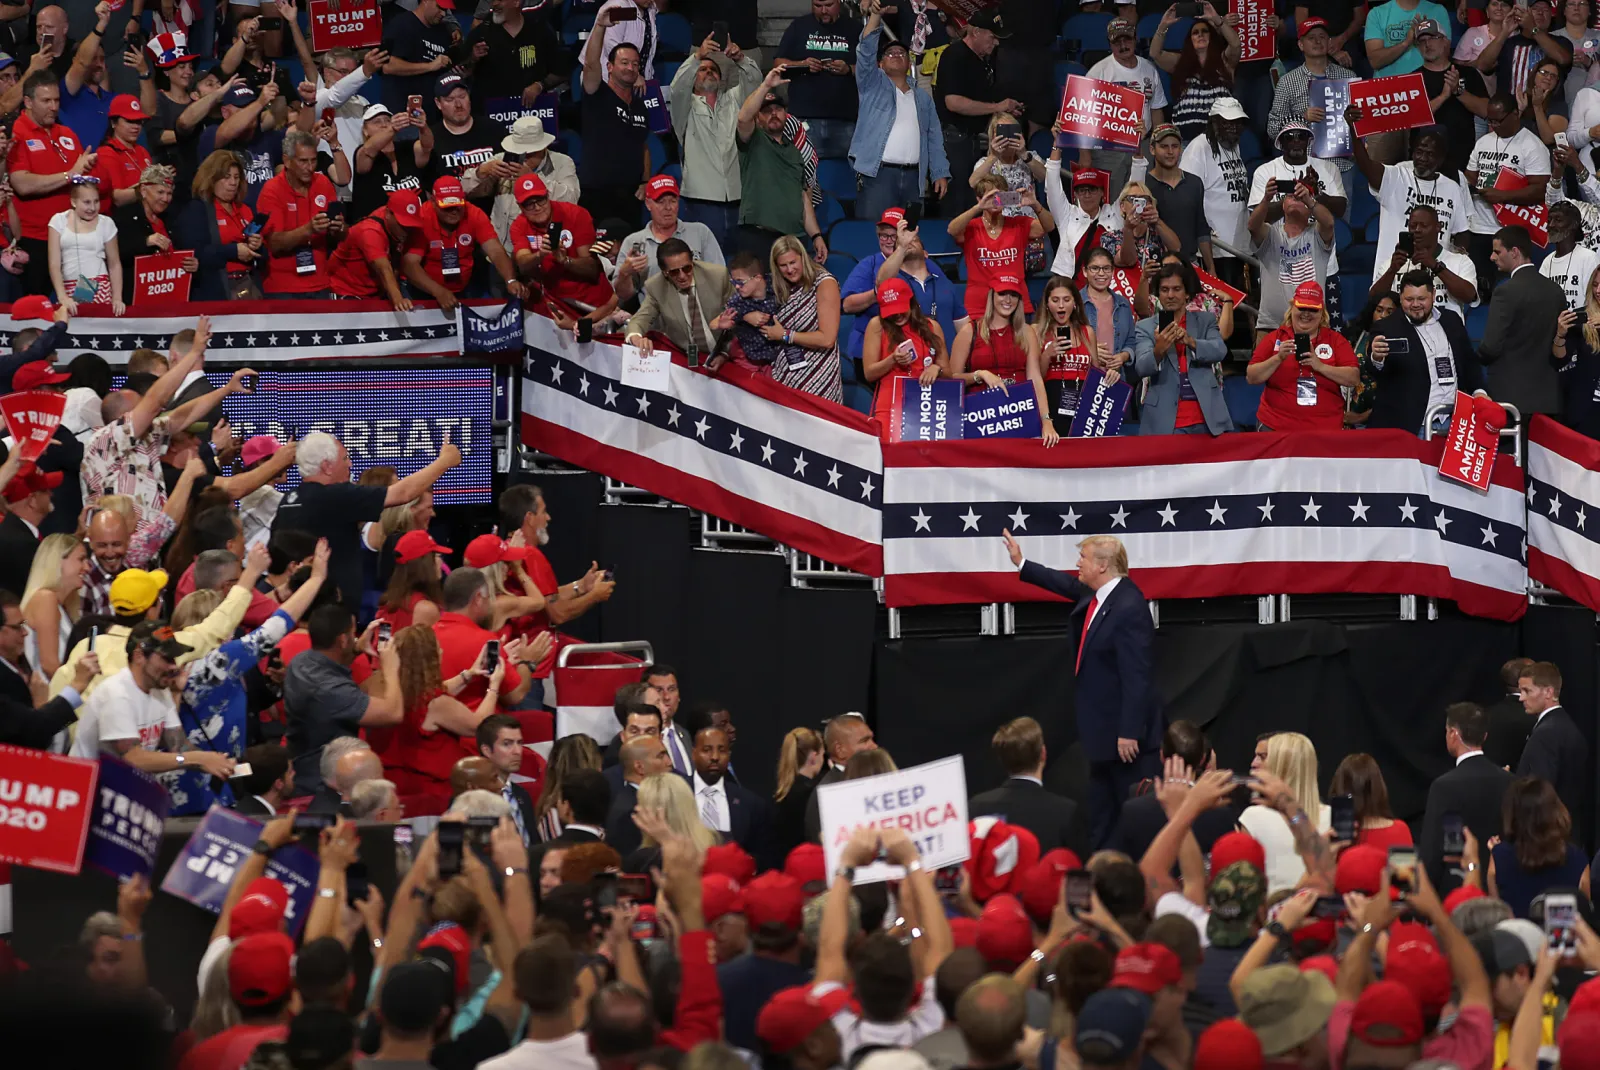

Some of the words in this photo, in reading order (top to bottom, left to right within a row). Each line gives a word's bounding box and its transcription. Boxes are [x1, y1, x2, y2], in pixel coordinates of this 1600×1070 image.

[316, 9, 376, 25] TRUMP
[1237, 0, 1245, 27] REAT
[330, 22, 364, 34] 2020
[1247, 0, 1259, 58] MERICA
[1260, 9, 1268, 37] MAKE
[806, 39, 850, 52] SWAMP
[809, 34, 831, 42] DRAIN
[1238, 28, 1246, 59] AGAIN
[1091, 88, 1122, 105] MAKE
[1354, 90, 1420, 108] TRUMP
[520, 108, 554, 119] MORE
[1066, 97, 1138, 124] AMERICA
[1324, 86, 1337, 150] TRUMP
[1335, 92, 1344, 144] PENCE
[1371, 104, 1410, 117] 2020
[1063, 112, 1100, 131] GREAT
[1103, 119, 1137, 136] AGAIN
[441, 151, 494, 168] Trump
[1478, 151, 1510, 162] TRUMP
[1510, 155, 1520, 165] &
[1446, 199, 1454, 210] &
[1505, 202, 1549, 232] TRUM
[977, 247, 1018, 263] Trump
[1280, 243, 1312, 257] TRUMP
[139, 268, 186, 284] TRUMP
[1571, 276, 1579, 288] &
[148, 282, 174, 295] 2020
[468, 308, 519, 332] TRUMP
[483, 335, 509, 347] AMERICA
[919, 384, 932, 412] MORE
[1089, 376, 1107, 416] MORE
[998, 399, 1035, 416] MORE
[12, 410, 61, 428] TRUMP
[977, 417, 1024, 437] YEARS!
[1453, 418, 1467, 451] MAKE
[1471, 447, 1488, 482] GREAT
[0, 780, 80, 811] UMP
[864, 785, 925, 814] KEEP
